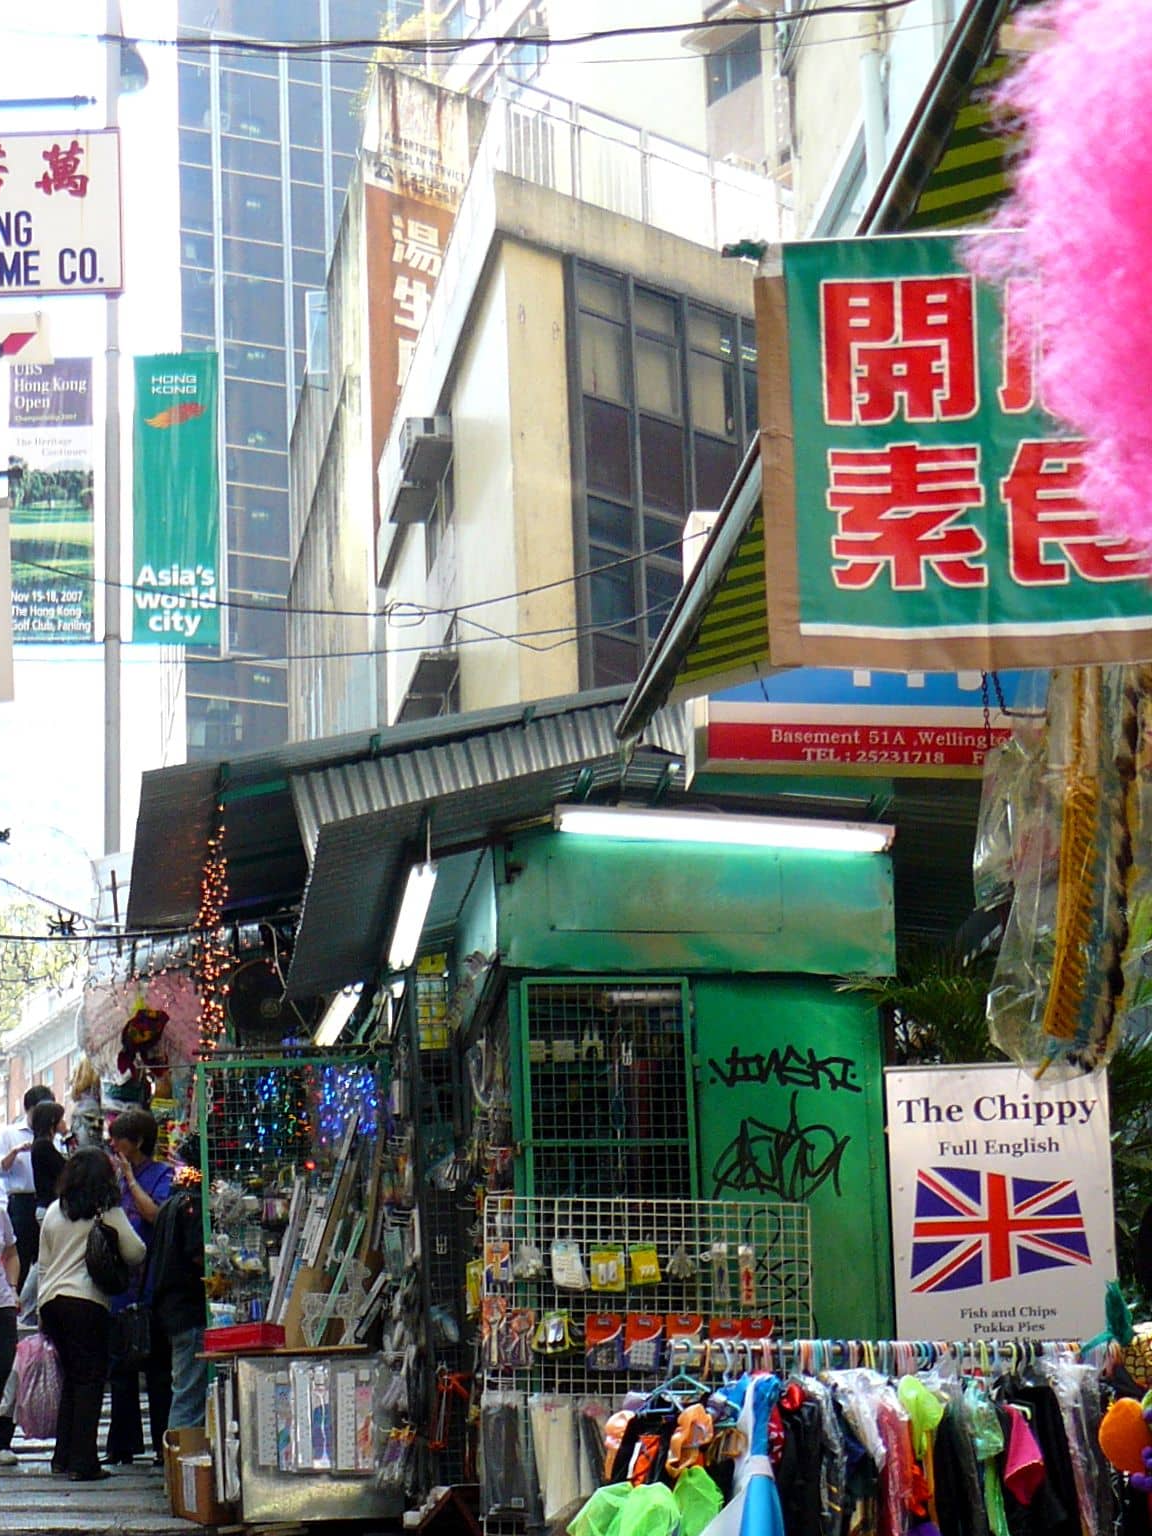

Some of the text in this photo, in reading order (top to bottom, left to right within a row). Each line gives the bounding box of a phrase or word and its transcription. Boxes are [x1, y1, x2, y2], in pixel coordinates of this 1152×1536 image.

[58, 247, 105, 285] CO.
[14, 376, 87, 394] Hong Kong
[151, 375, 197, 384] HONG
[151, 385, 197, 394] KONG
[14, 395, 50, 412] Open
[136, 564, 215, 587] Asia's
[10, 590, 29, 602] Nov
[61, 591, 83, 602] 2007
[135, 587, 217, 610] world
[12, 605, 81, 619] The Hong Kong
[57, 620, 91, 633] Fanling
[148, 612, 201, 637] city
[771, 728, 861, 745] Basement
[868, 730, 907, 746] 51A
[802, 748, 841, 762] TEL
[856, 751, 944, 763] 25231718
[897, 1093, 1097, 1126] The Chippy
[939, 1137, 1060, 1158] Full English
[960, 1306, 1057, 1320] Fish and Chips
[973, 1321, 1046, 1334] Pukka Pies
